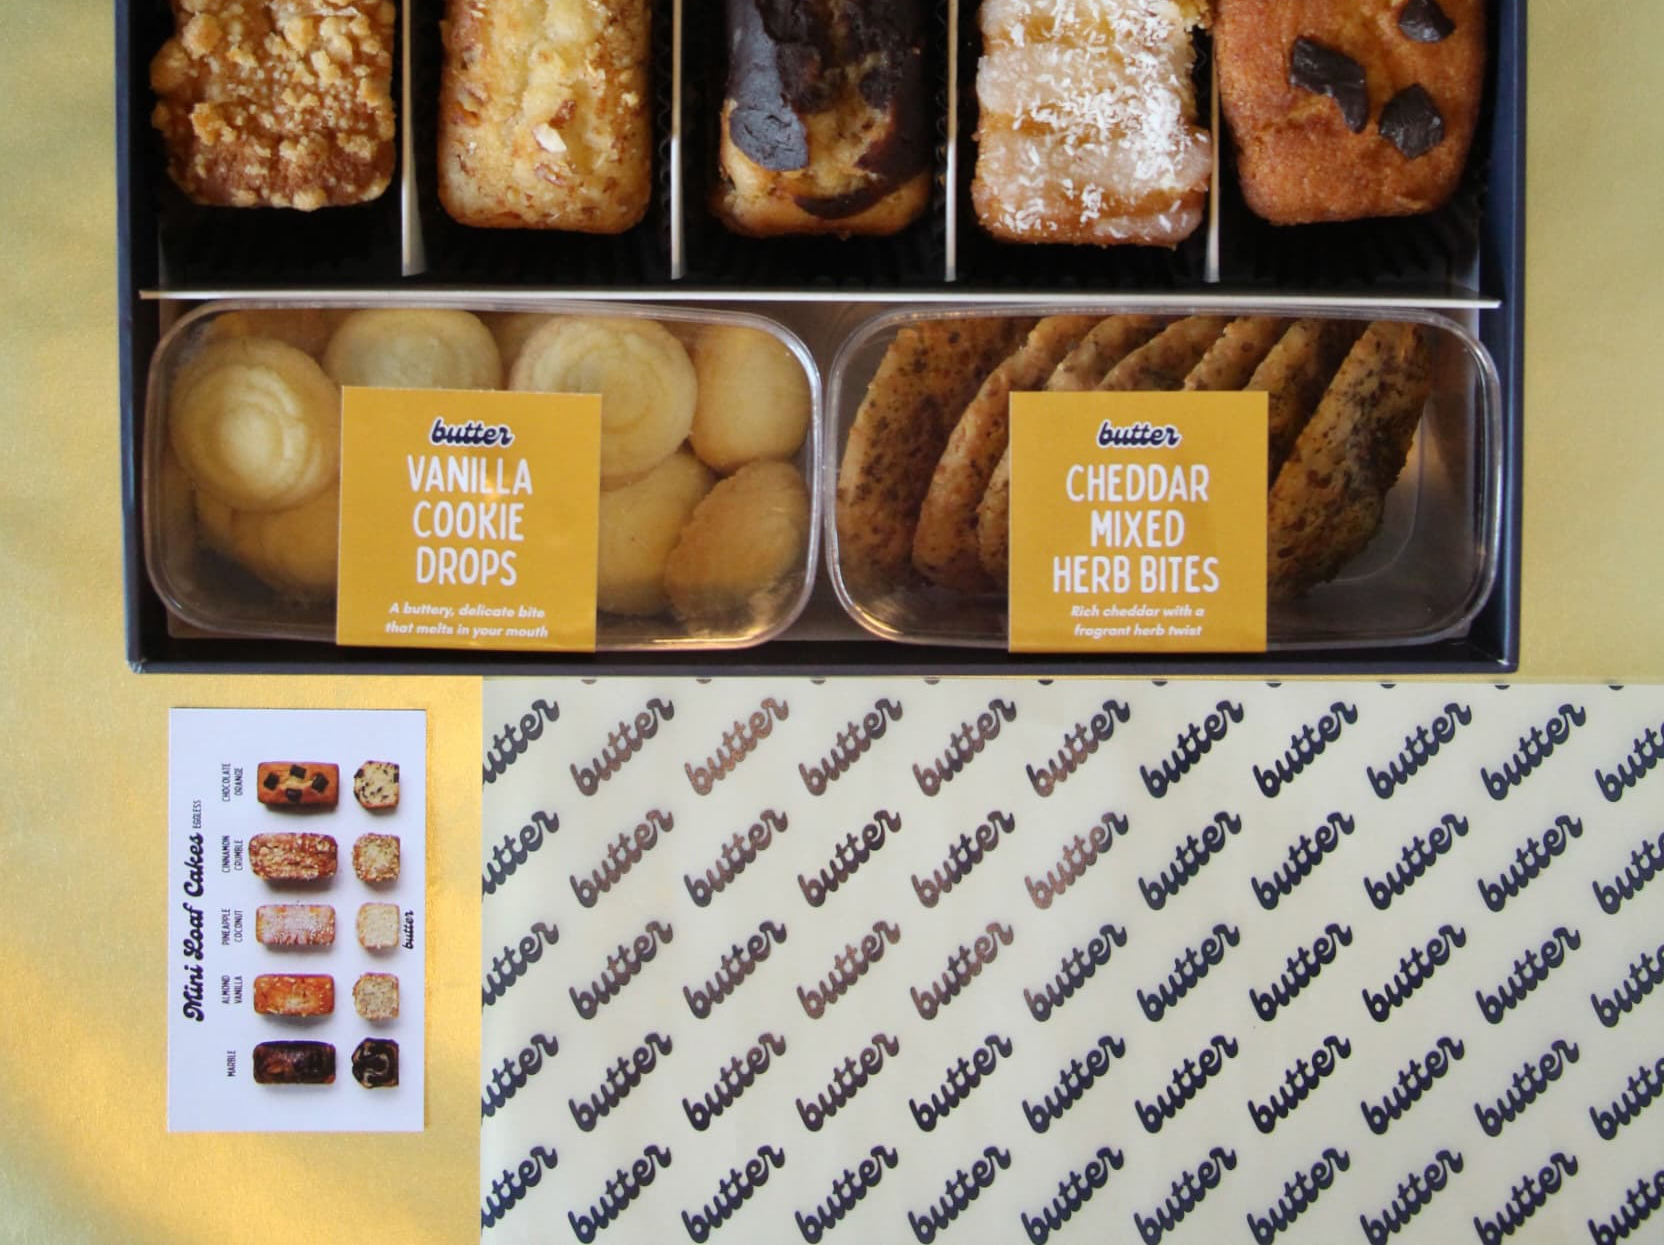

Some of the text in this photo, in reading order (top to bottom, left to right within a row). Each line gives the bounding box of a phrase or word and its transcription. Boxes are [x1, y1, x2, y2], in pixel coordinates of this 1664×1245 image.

[407, 454, 533, 495] VANILLA
[430, 417, 515, 446] butter
[1097, 420, 1182, 448] butter
[412, 501, 525, 542] COOKIE
[1066, 464, 1210, 502] CHEDDAR
[1090, 510, 1185, 548] MIXED
[388, 601, 545, 619] A buttery, delicate bite
[416, 546, 518, 586] DROPS
[1053, 556, 1220, 593] HERB BITES
[1071, 604, 1205, 617] Rich cheddar with a
[385, 620, 548, 639] that melts in your mouth
[1074, 623, 1202, 639] fragrant herb twist
[221, 761, 232, 803] CHOCOLATE
[233, 766, 244, 797] ORANGE
[481, 699, 560, 785] utter
[570, 698, 674, 796] butter
[685, 698, 789, 796] butter
[799, 698, 903, 796] butter
[912, 699, 1017, 797] butter
[1026, 699, 1131, 797] butter
[1140, 700, 1244, 799] butter
[1252, 701, 1358, 798] butter
[1366, 703, 1472, 799] butter
[1480, 704, 1586, 801] butter
[1595, 722, 1664, 802] butt
[191, 798, 203, 830] EGGLESS
[221, 834, 232, 874] CINNAMON
[233, 839, 244, 872] CRUMBLE
[481, 811, 559, 896] utter
[570, 810, 674, 908] butter
[684, 810, 788, 907] butter
[798, 810, 901, 907] butter
[911, 811, 1015, 908] butter
[1025, 812, 1129, 909] butter
[1138, 811, 1242, 911] butter
[1251, 812, 1355, 910] butter
[1363, 814, 1469, 910] butter
[1477, 815, 1583, 912] butter
[1592, 832, 1664, 915] butt
[183, 832, 204, 1022] Mini Loaf Cakes
[221, 907, 232, 946] PINEAPPLE
[233, 909, 244, 944] COCONUT
[402, 910, 414, 950] butter
[481, 922, 559, 1010] utter
[569, 921, 673, 1020] butter
[683, 921, 787, 1019] butter
[797, 921, 900, 1019] butter
[910, 922, 1014, 1020] butter
[1024, 924, 1127, 1022] butter
[1136, 923, 1240, 1022] butter
[1249, 923, 1353, 1022] butter
[1362, 924, 1467, 1023] butter
[221, 974, 231, 1005] ALMOND
[233, 974, 244, 1005] VANILLA
[1475, 927, 1581, 1025] butter
[1590, 944, 1664, 1028] butt
[225, 1049, 237, 1078] MARBLE
[481, 1034, 559, 1119] utter
[568, 1032, 673, 1132] butter
[682, 1032, 786, 1131] butter
[796, 1034, 899, 1132] butter
[909, 1035, 1013, 1132] butter
[1022, 1035, 1126, 1134] butter
[1134, 1035, 1239, 1134] butter
[1247, 1035, 1352, 1134] butter
[1360, 1036, 1465, 1136] butter
[1474, 1039, 1580, 1137] butter
[481, 1146, 558, 1229] utter
[568, 1145, 672, 1244] butter
[681, 1145, 785, 1244] butter
[795, 1145, 899, 1245] butter
[908, 1146, 1012, 1245] butter
[1021, 1146, 1125, 1245] butter
[1133, 1146, 1237, 1245] butter
[1246, 1147, 1351, 1245] butter
[1359, 1149, 1464, 1245] butter
[1473, 1152, 1579, 1245] butter
